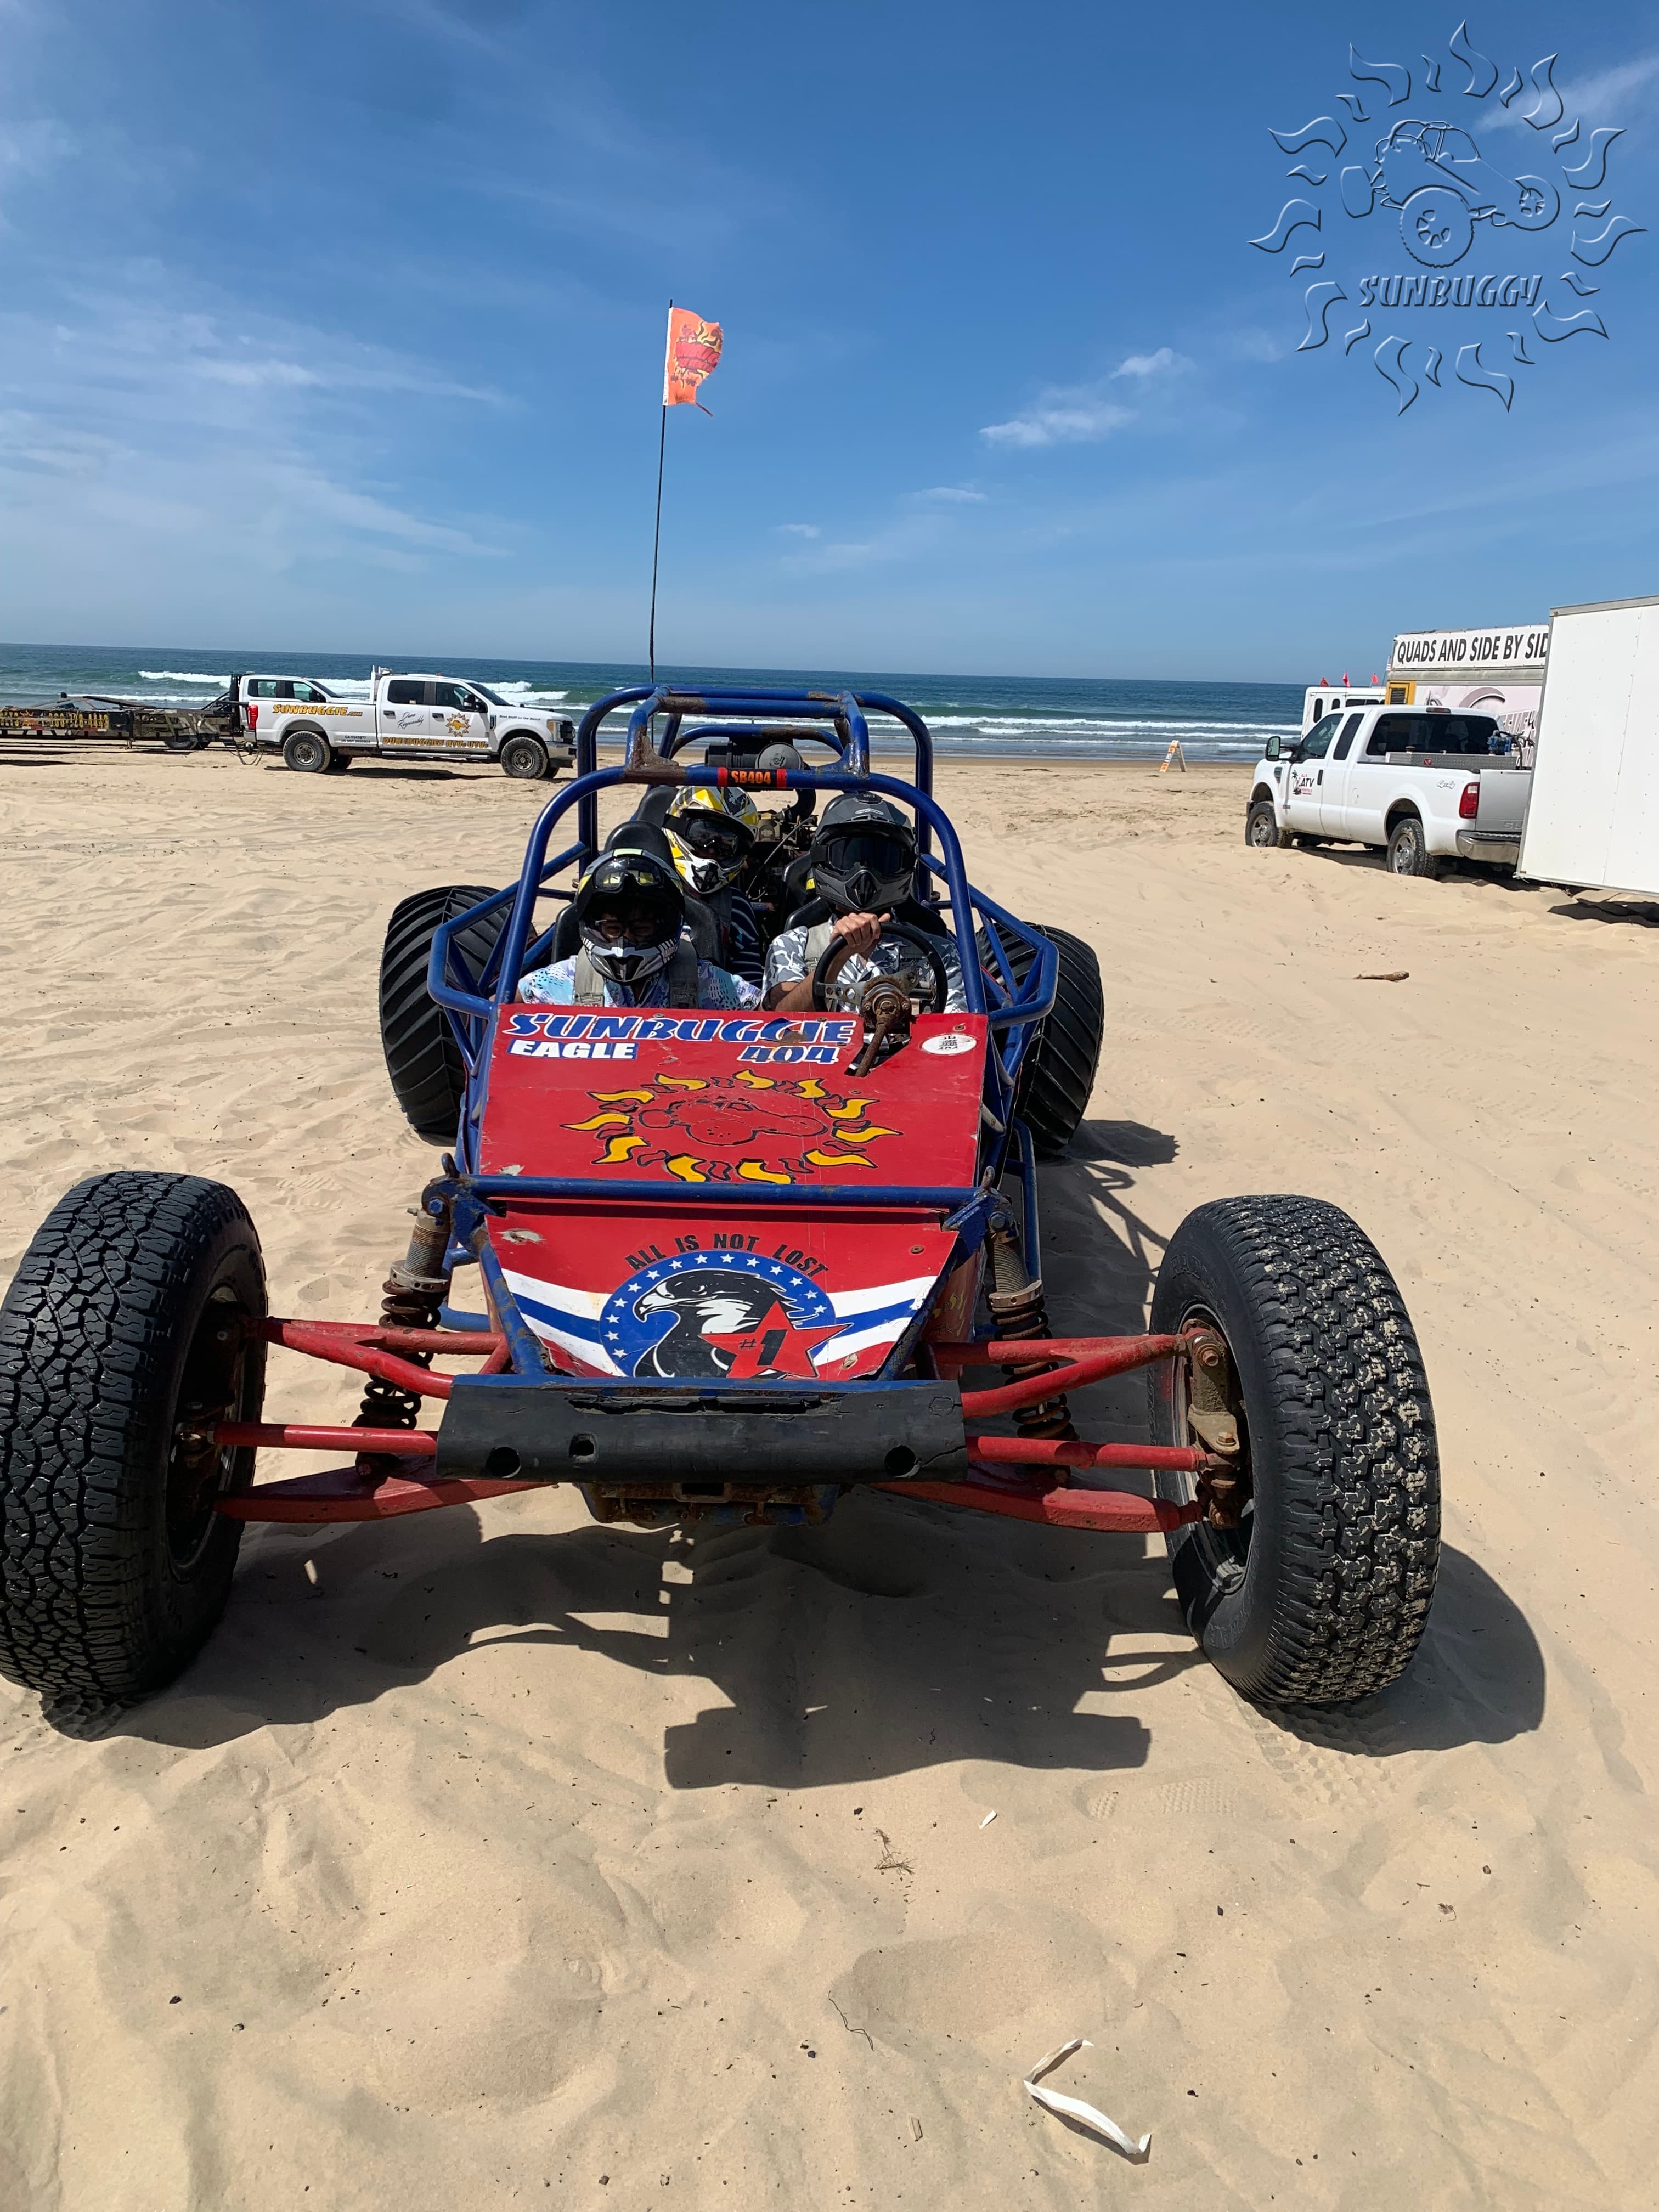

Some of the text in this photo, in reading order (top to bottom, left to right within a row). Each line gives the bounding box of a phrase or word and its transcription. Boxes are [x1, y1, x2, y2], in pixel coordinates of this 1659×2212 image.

[1397, 640, 1437, 664] QUADS
[1437, 639, 1467, 662] AND
[1469, 636, 1501, 661] SIDE
[1503, 634, 1524, 659] BY
[730, 770, 771, 784] SB404
[1300, 777, 1314, 787] ATV
[502, 1013, 857, 1043] SUNBUGGIE
[509, 1039, 840, 1064] EAGLE 404
[625, 1233, 830, 1277] ALL IS NOT LOST
